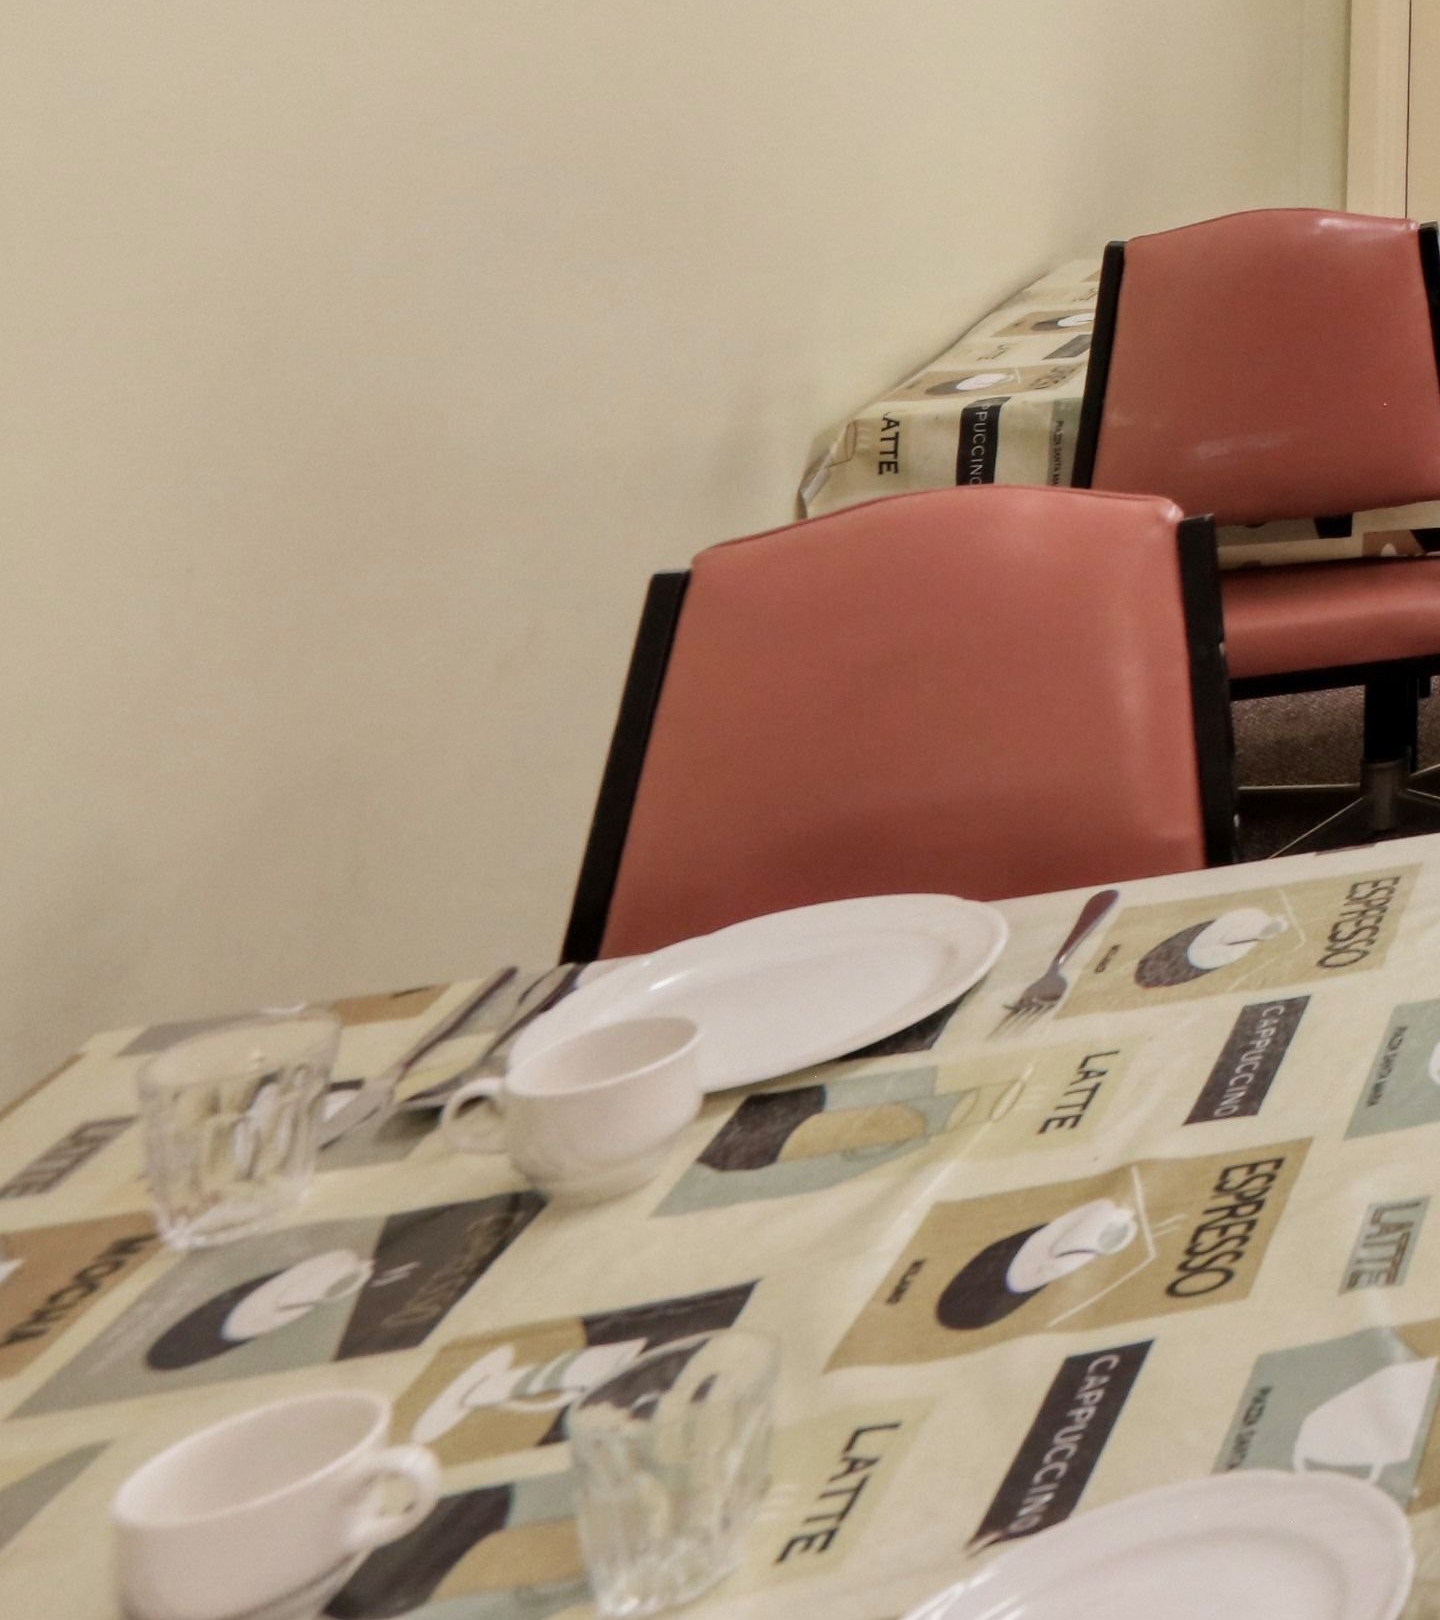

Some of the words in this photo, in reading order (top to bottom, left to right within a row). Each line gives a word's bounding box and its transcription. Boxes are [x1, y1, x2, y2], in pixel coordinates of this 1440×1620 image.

[877, 412, 900, 476] ATTE
[969, 404, 989, 485] PPUCCINO
[1316, 875, 1402, 969] ESPRESSO
[1037, 1049, 1120, 1135] LATTE
[1213, 1003, 1286, 1119] CAPPUCCINO
[1166, 1156, 1285, 1298] ESPRESSO
[1348, 1201, 1422, 1289] LATTE
[1007, 1353, 1119, 1533] CAPPUCCINO
[773, 1422, 902, 1566] LATTE
